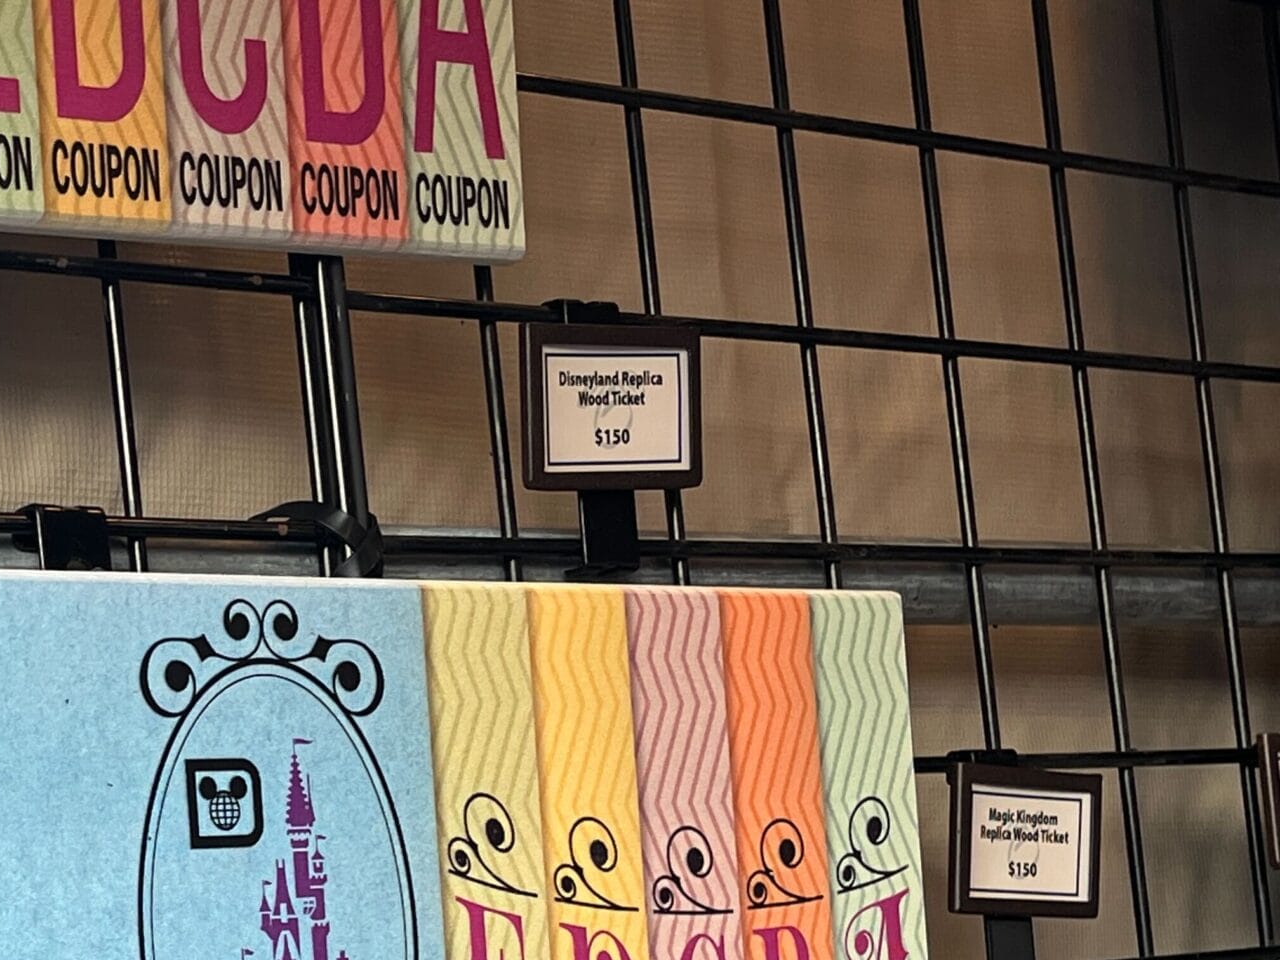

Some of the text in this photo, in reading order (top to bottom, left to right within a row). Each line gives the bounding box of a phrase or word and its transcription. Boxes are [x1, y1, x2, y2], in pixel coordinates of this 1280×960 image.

[51, 139, 162, 202] COUPON
[178, 151, 284, 212] COUPON
[299, 162, 400, 221] COUPON
[414, 172, 510, 230] COUPON
[558, 371, 663, 390] Disneyland Replica
[578, 391, 646, 406] Wood Ticket
[594, 428, 630, 446] $150
[988, 808, 1058, 828] Magic Kingdom
[980, 825, 1069, 844] Replica Wood Ticket
[1008, 861, 1038, 877] $150
